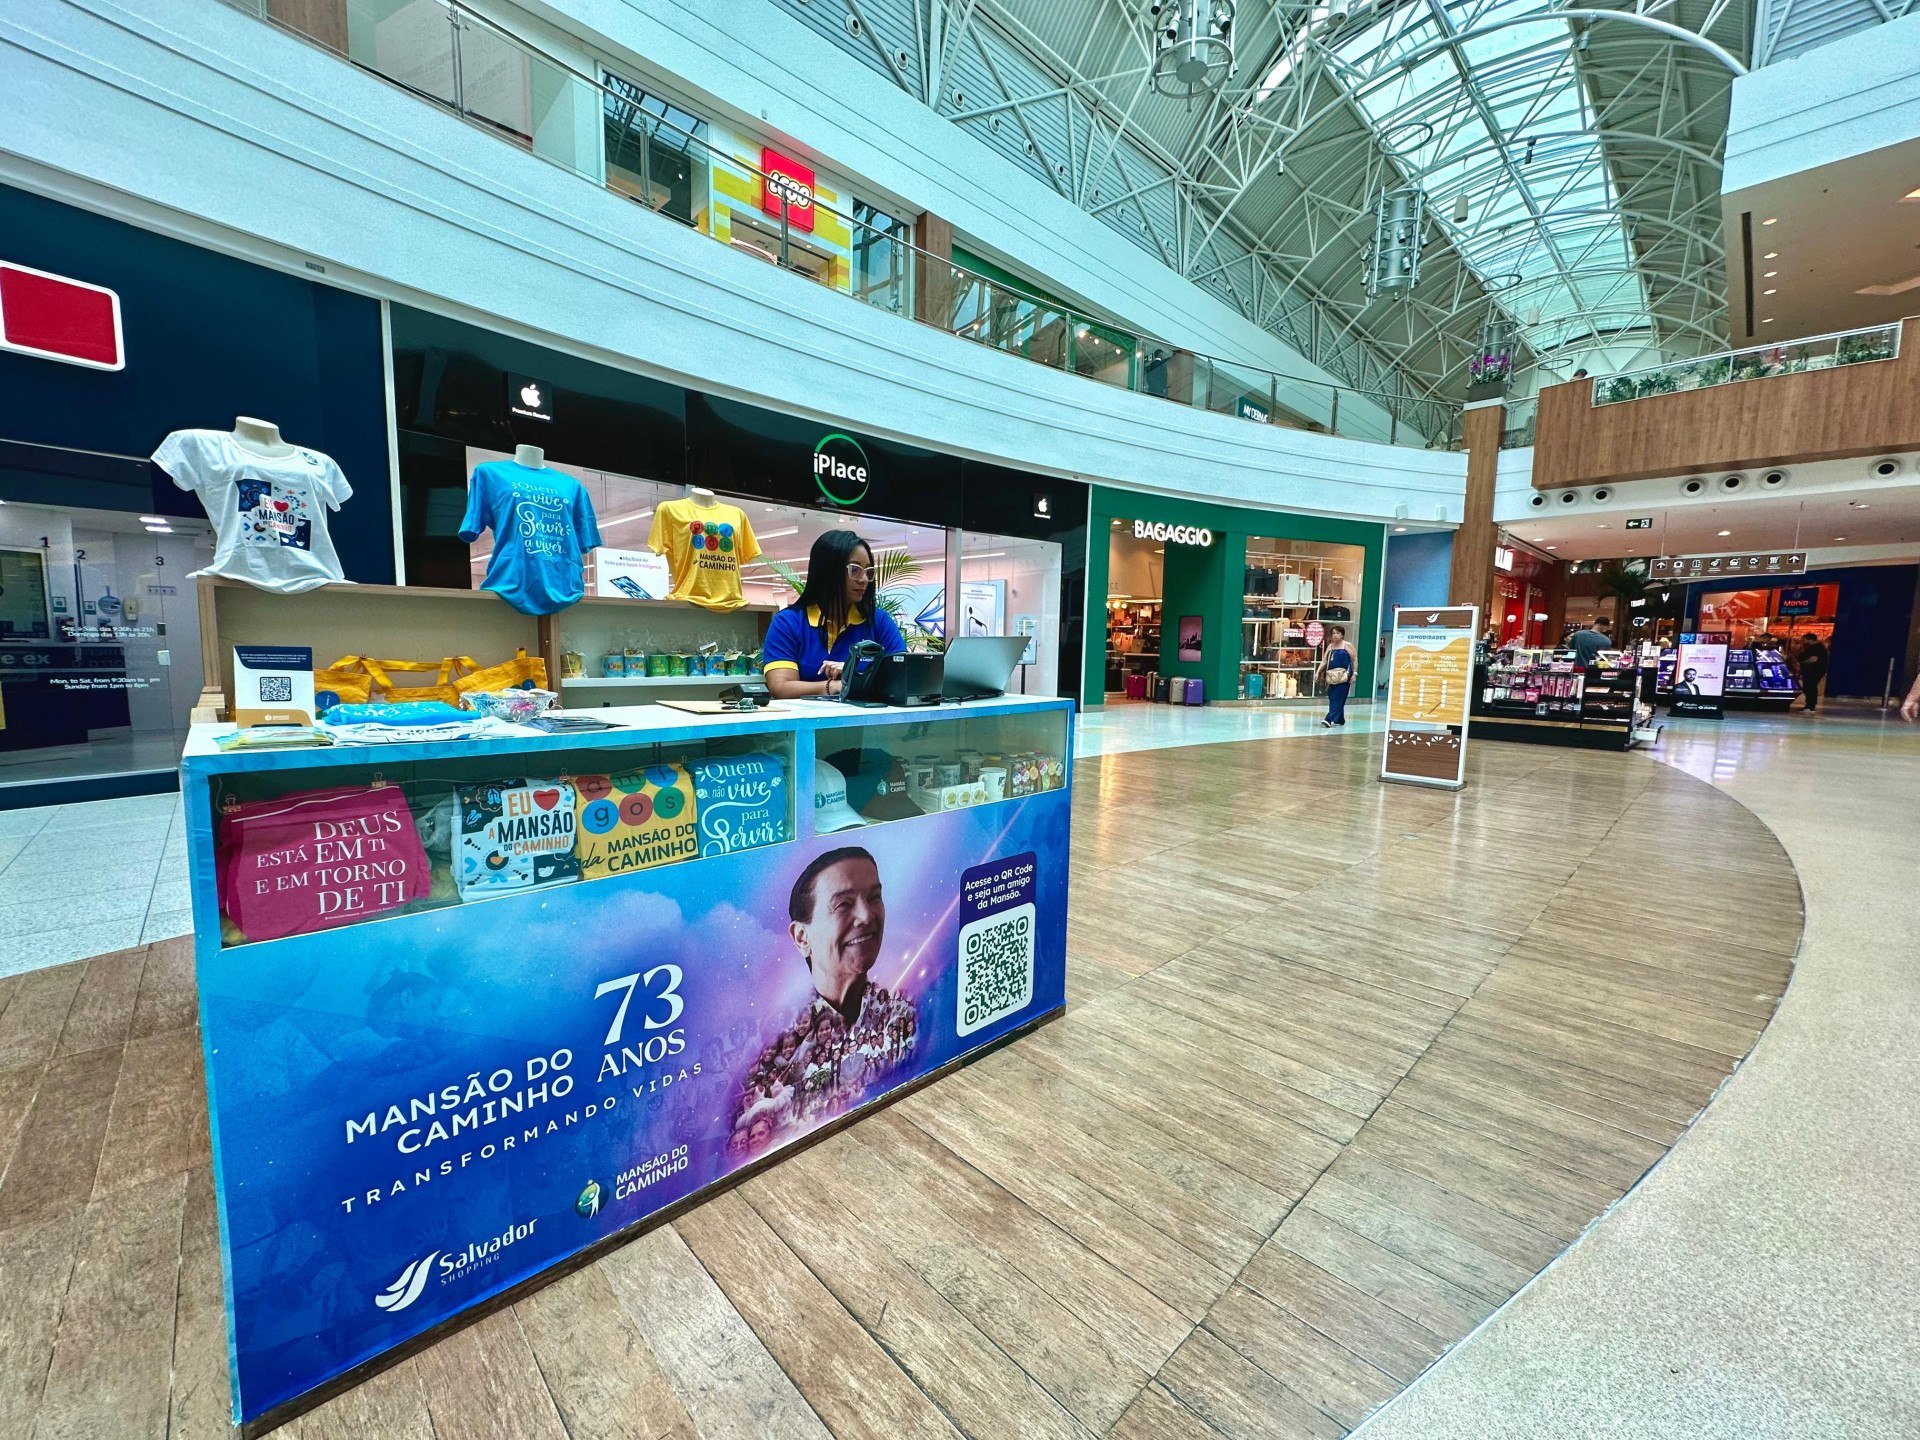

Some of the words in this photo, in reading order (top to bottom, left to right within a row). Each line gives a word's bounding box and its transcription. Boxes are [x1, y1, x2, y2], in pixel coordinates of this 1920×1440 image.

[813, 452, 867, 483] iPlace
[517, 481, 558, 494] Quem
[533, 493, 563, 510] vive
[541, 512, 561, 520] para
[39, 537, 50, 548] 1
[1134, 519, 1212, 547] BAGAGGIO
[76, 549, 86, 560] 2
[155, 556, 165, 566] 3
[699, 561, 735, 571] CAMINHO
[705, 761, 765, 783] Quem
[507, 790, 532, 817] EU
[712, 786, 725, 798] não
[728, 778, 771, 800] vive
[313, 810, 402, 841] DEUS
[488, 827, 495, 840] A
[497, 809, 573, 844] MANSÃO
[741, 808, 770, 826] para
[256, 844, 308, 869] ESTÁ
[314, 837, 364, 864] EM
[367, 838, 386, 852] TI
[504, 843, 513, 851] DO
[513, 835, 570, 856] CAMINHO
[582, 842, 606, 869] da
[607, 828, 671, 854] MANSÃO
[676, 823, 695, 838] DO
[607, 838, 697, 872] CAMINHO
[255, 878, 269, 895] E
[276, 871, 309, 891] EM
[315, 859, 406, 886] TORNO
[964, 877, 992, 892] Acesse
[994, 874, 1000, 882] o
[1001, 869, 1013, 880] QR
[1014, 863, 1033, 876] Code
[967, 894, 973, 902] e
[974, 887, 991, 899] seja
[993, 883, 1006, 894] um
[1007, 876, 1031, 889] amigo
[317, 885, 364, 916] DE
[373, 880, 406, 905] TI
[977, 899, 988, 910] da
[990, 890, 1021, 906] Mansão.
[594, 963, 685, 1047] 73
[596, 1028, 687, 1083] ANOS
[345, 1068, 513, 1144] MANSÃO
[526, 1047, 574, 1083] DO
[396, 1075, 575, 1155] CAMINHO
[341, 1096, 616, 1214] TRANSFORMANDO
[632, 1062, 703, 1098] VIDAS
[615, 1156, 689, 1201] CAMINHO
[616, 1153, 669, 1186] MANSÃO
[671, 1143, 689, 1160] DO
[439, 1218, 538, 1278] Salvador
[440, 1252, 501, 1287] SHOPPING
